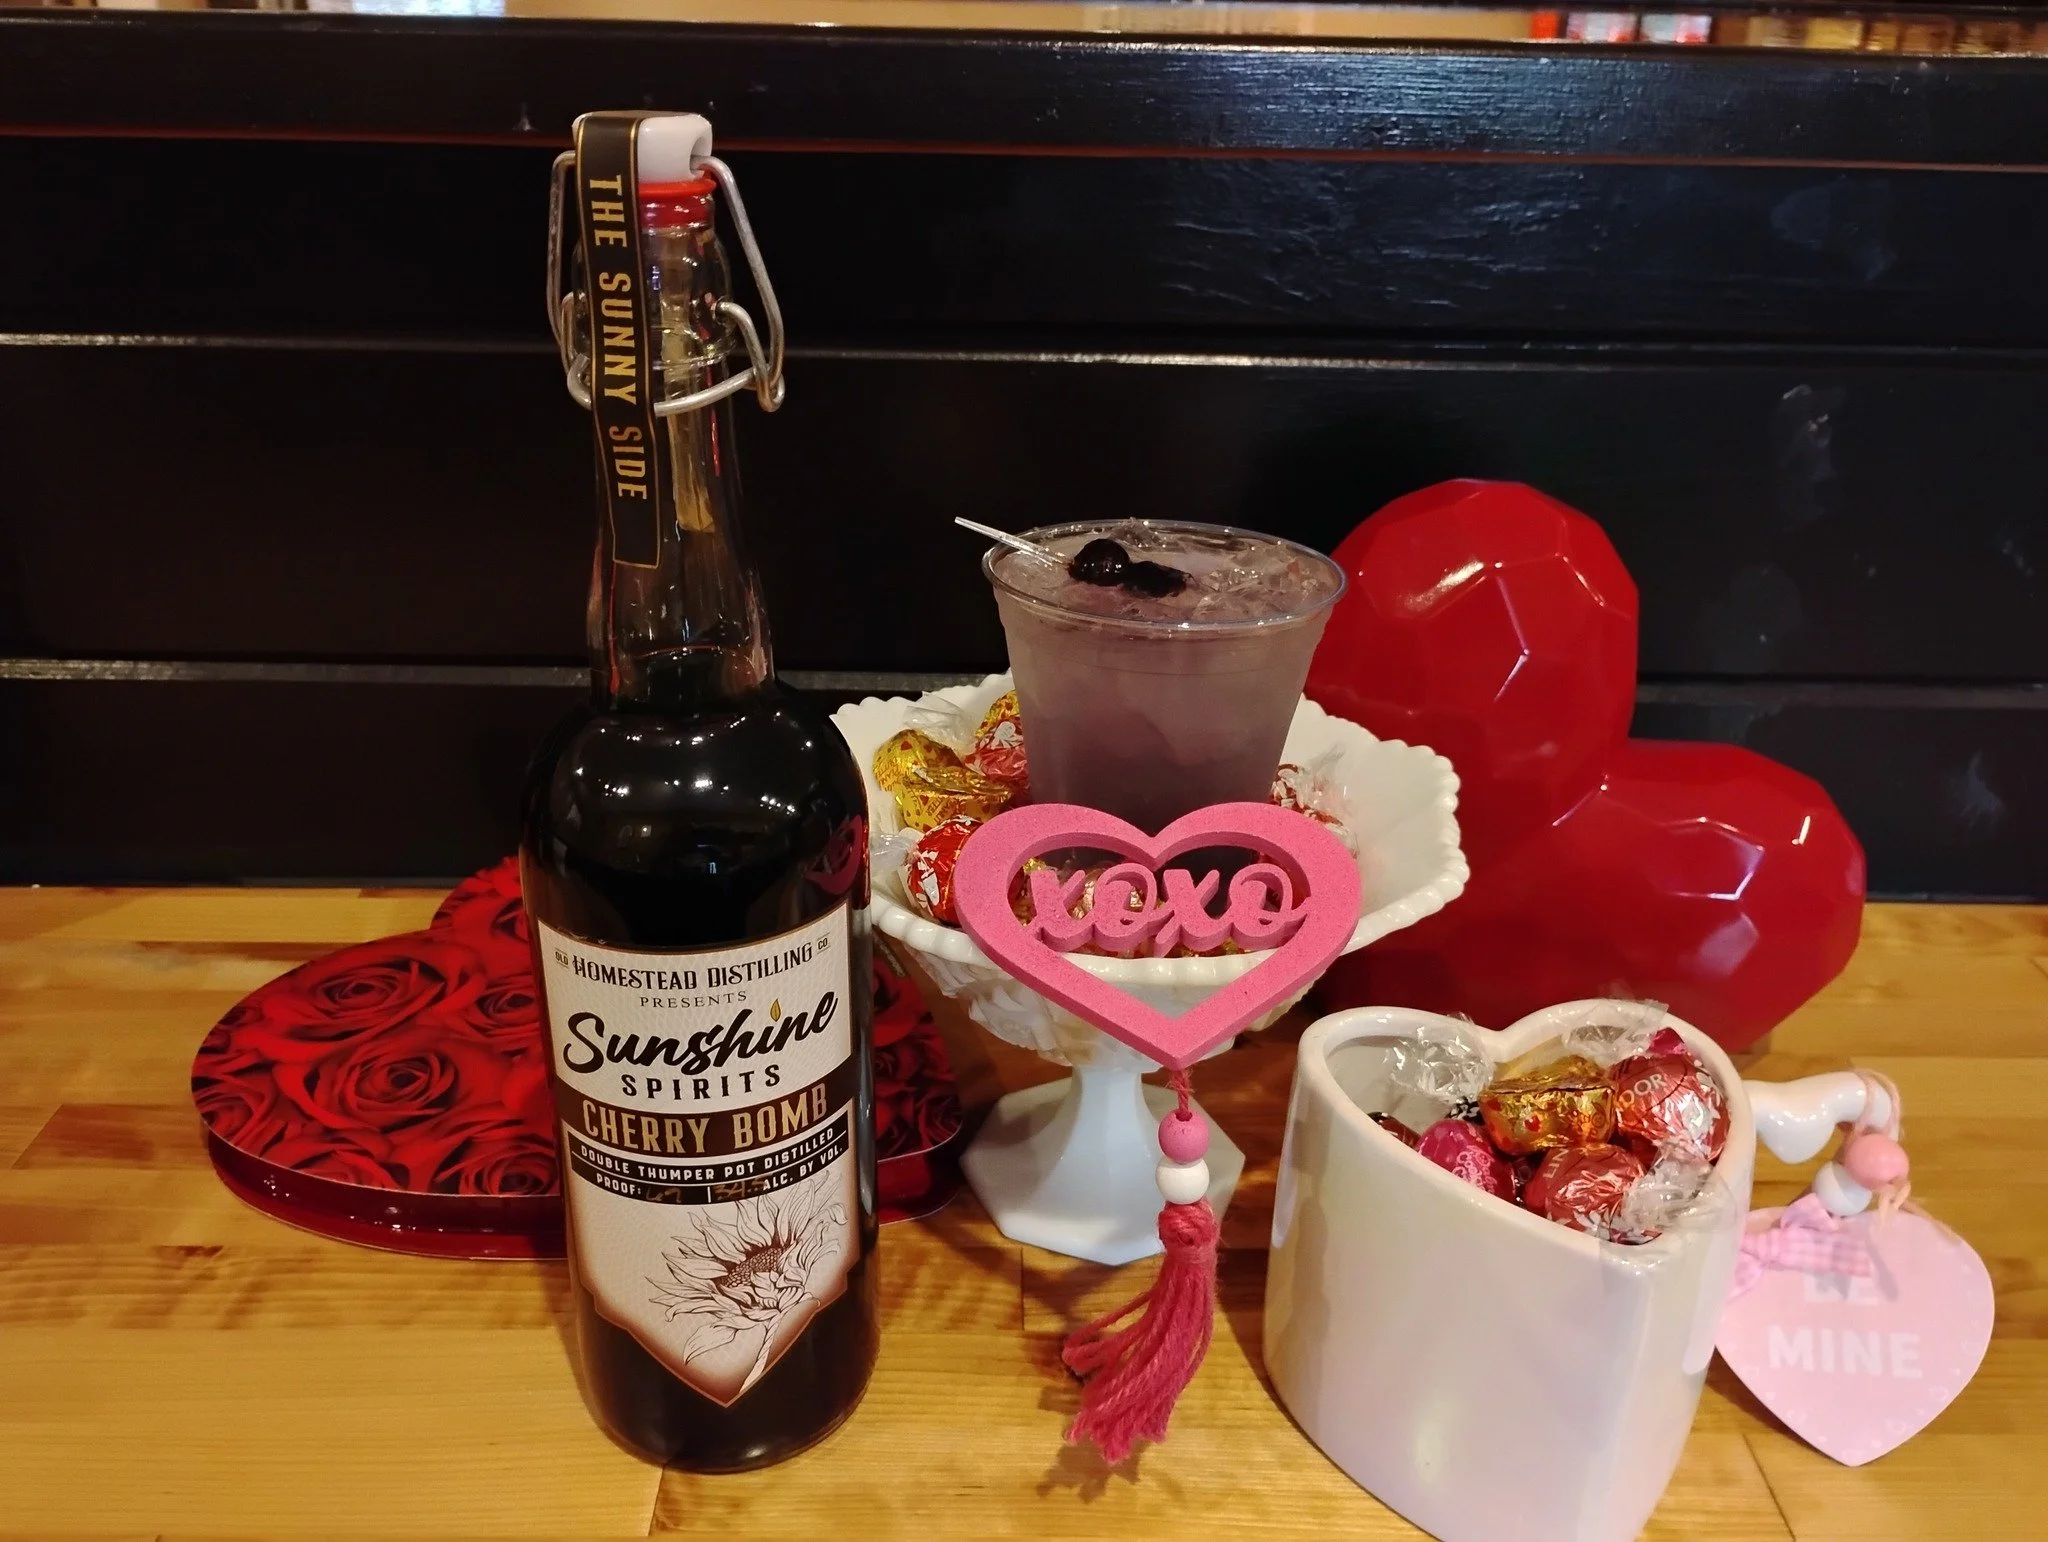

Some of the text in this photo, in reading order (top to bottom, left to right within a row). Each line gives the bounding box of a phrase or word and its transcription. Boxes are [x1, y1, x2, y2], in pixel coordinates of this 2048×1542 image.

[590, 174, 648, 501] THE SUNNY SIDE
[555, 950, 569, 966] OLD
[572, 955, 698, 990] HOMESTEAD
[707, 941, 813, 988] DISTILLING
[640, 990, 747, 1008] PRESENTS
[562, 991, 839, 1075] Sunshine
[621, 1064, 781, 1100] SPIRITS
[1619, 1073, 1663, 1109] DOR
[582, 1082, 828, 1154] CHERRY BOMB
[581, 1127, 834, 1181] DOUBLE THUMPER POT DISTILLED
[596, 1173, 641, 1195] PROOF:
[762, 1172, 793, 1191] ALC.
[800, 1161, 814, 1178] BY
[820, 1145, 842, 1165] VOL.
[1767, 1324, 1922, 1379] MINE
